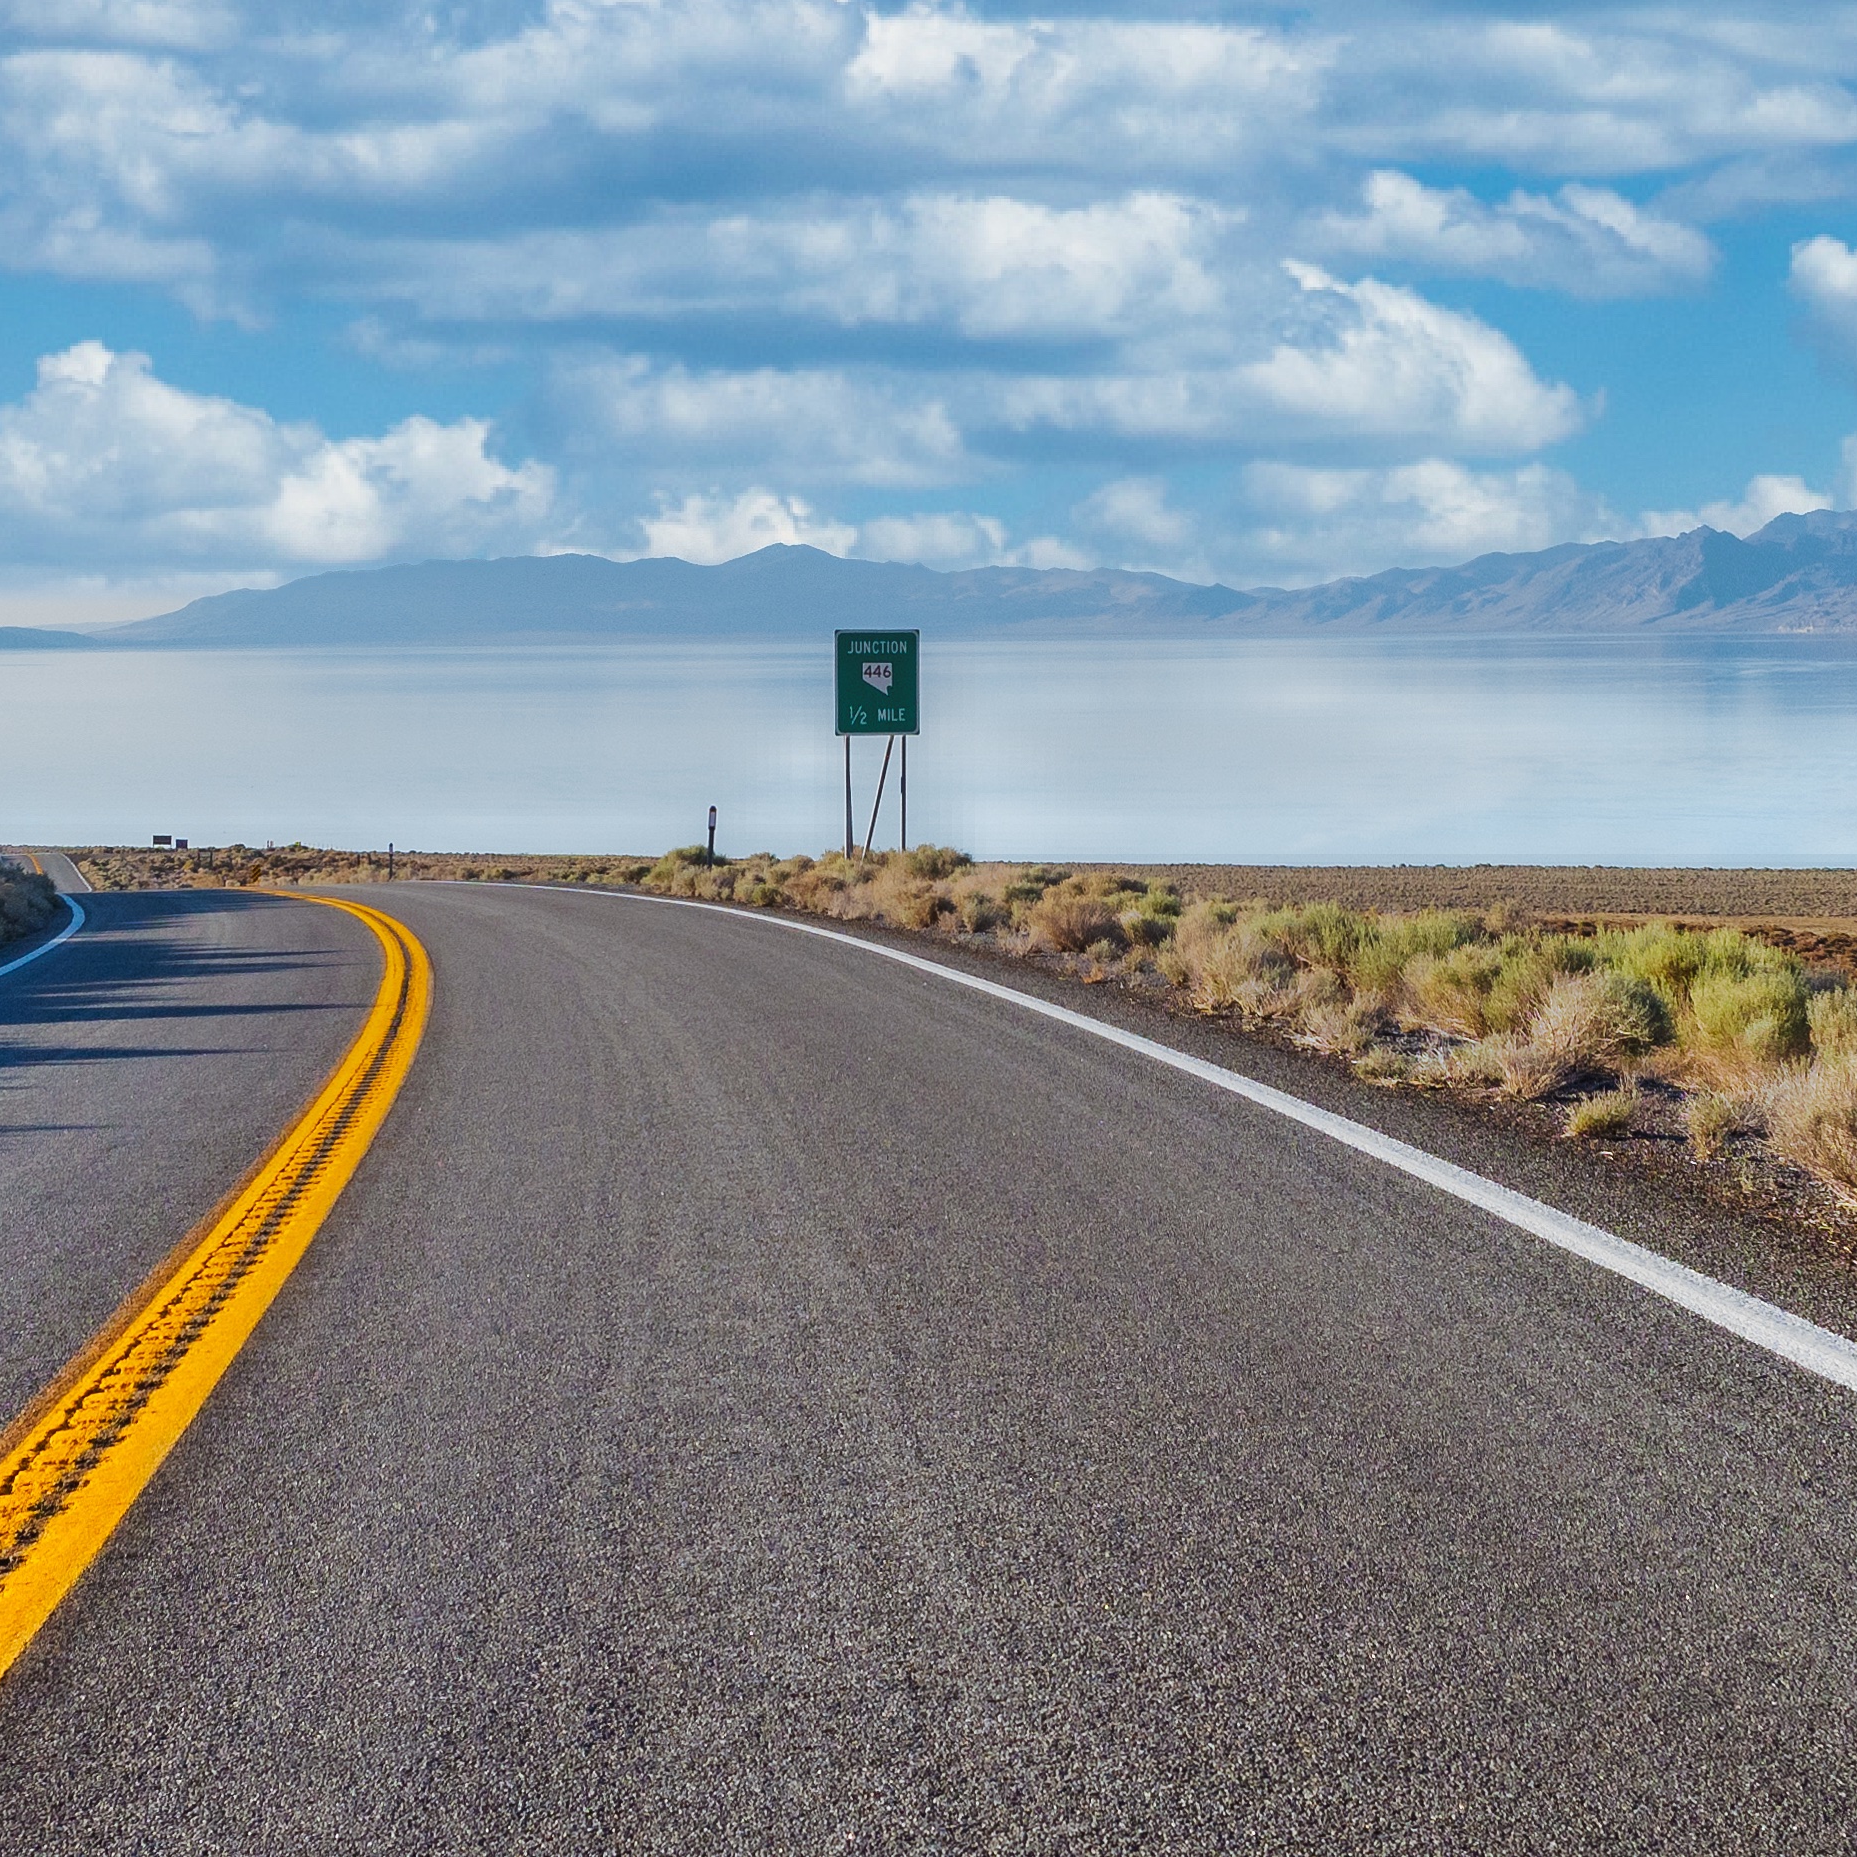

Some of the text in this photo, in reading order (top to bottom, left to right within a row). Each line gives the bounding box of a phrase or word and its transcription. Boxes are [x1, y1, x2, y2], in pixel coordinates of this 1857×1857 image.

[847, 640, 907, 654] JUNCTION
[863, 664, 892, 678] 446
[877, 708, 906, 722] MILE
